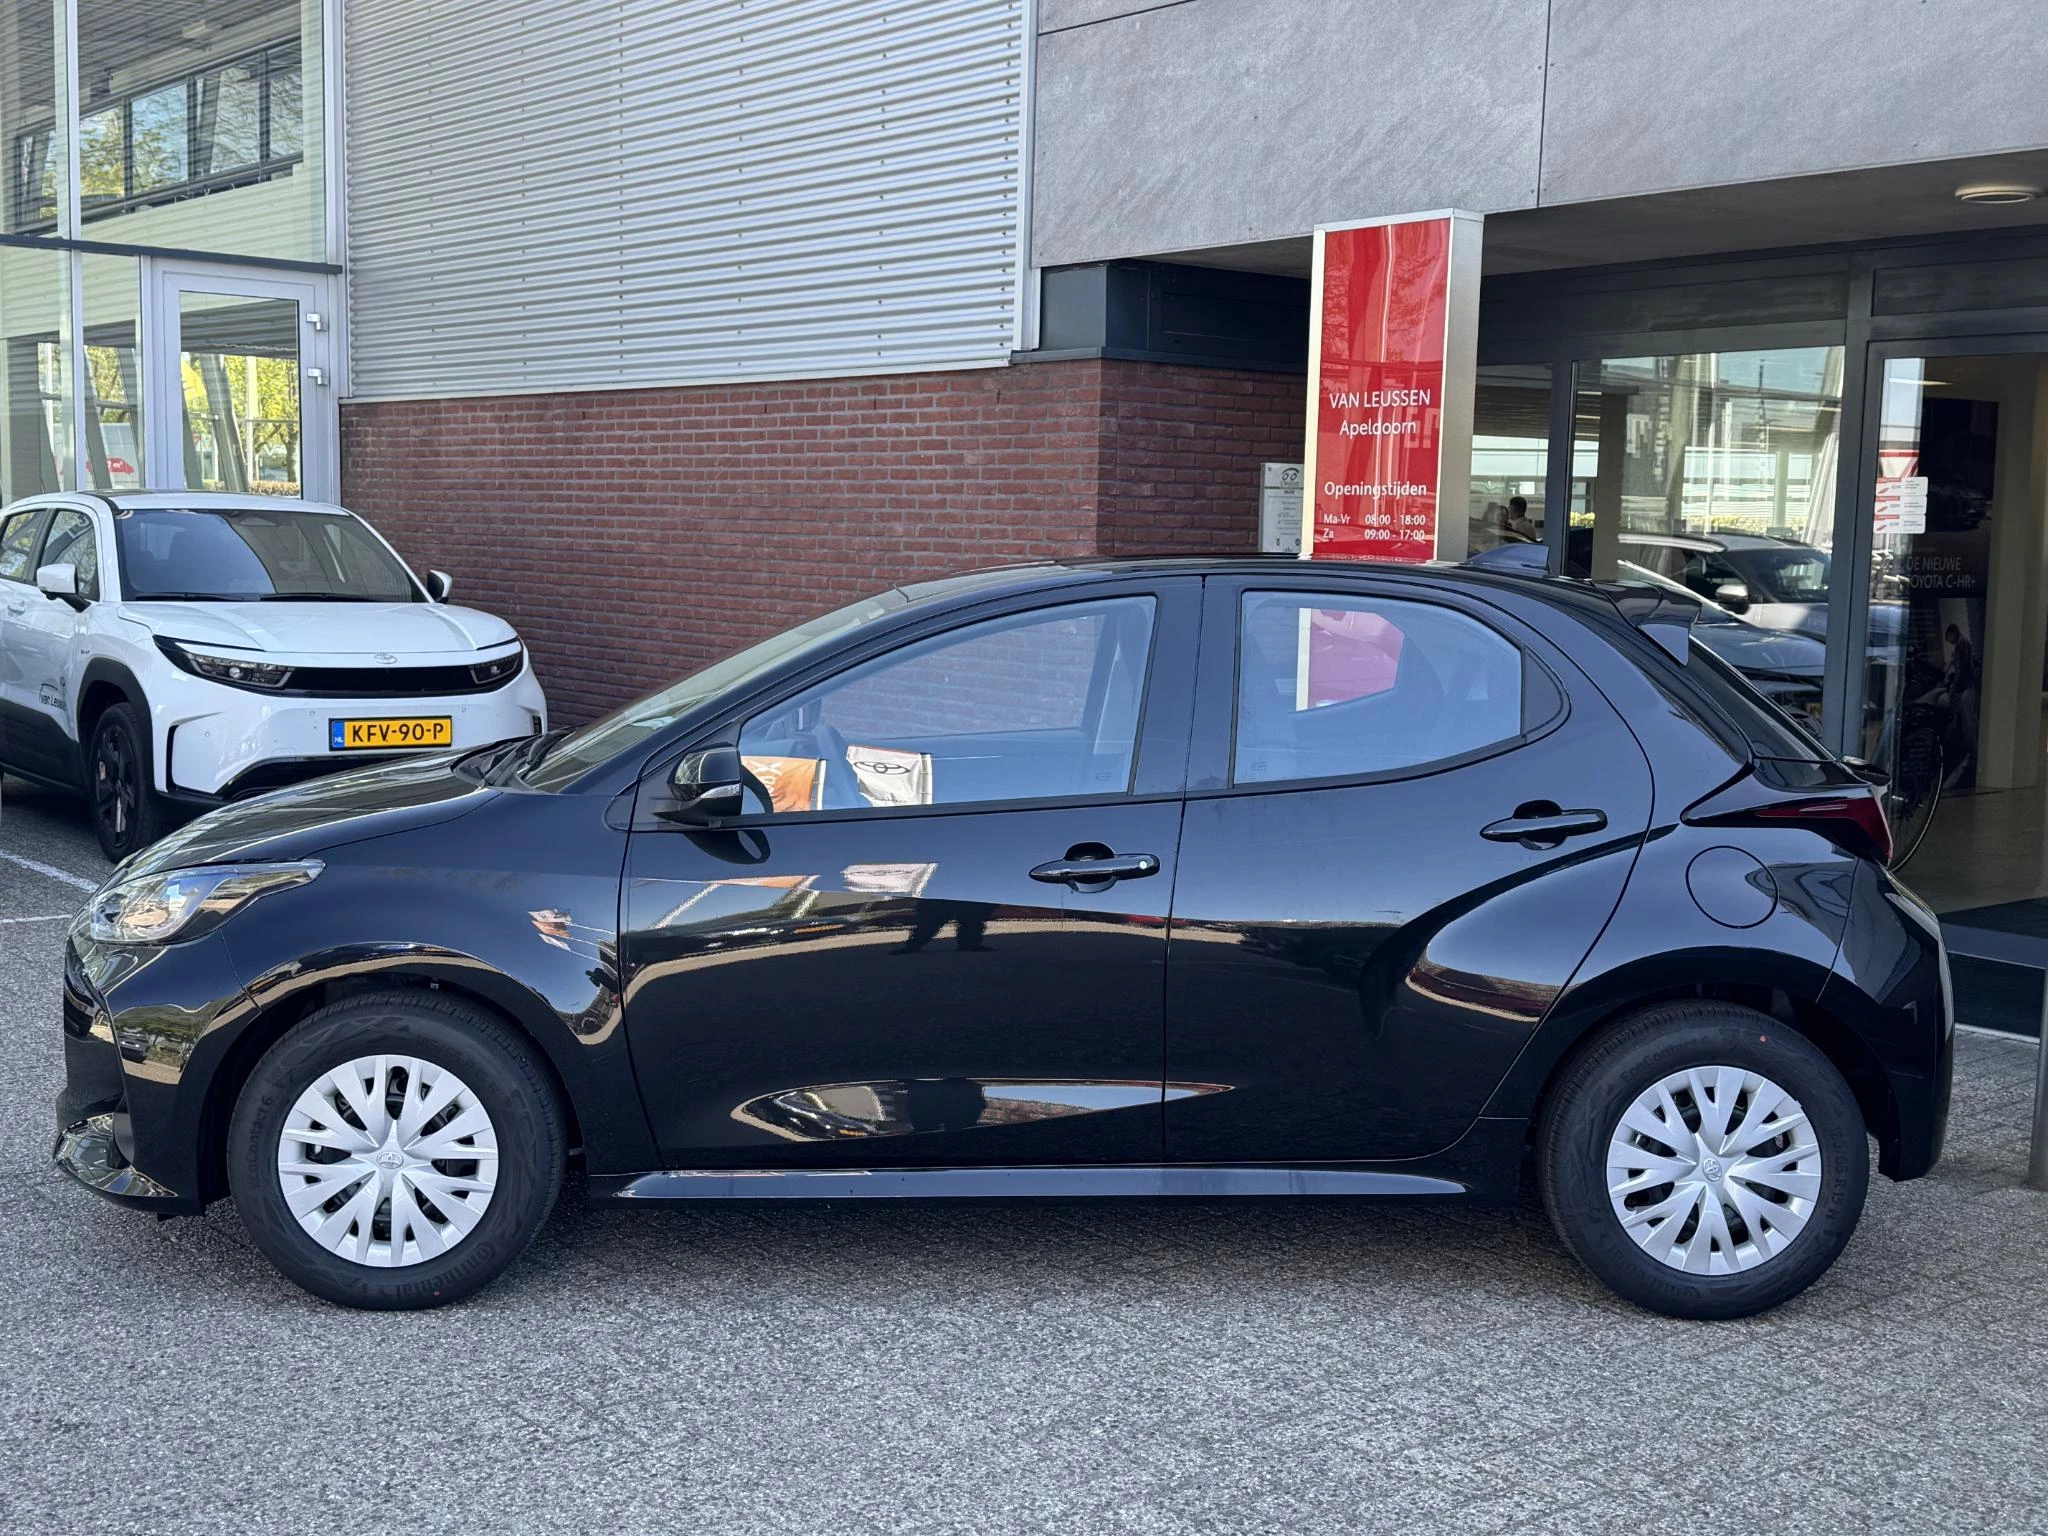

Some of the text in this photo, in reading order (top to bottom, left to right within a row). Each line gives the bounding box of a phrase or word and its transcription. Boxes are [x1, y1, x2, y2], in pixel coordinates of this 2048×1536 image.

[1330, 389, 1430, 408] VAN LEUSSEN
[1339, 419, 1416, 438] Apeldoorn
[1324, 481, 1427, 499] Openingstijden
[1323, 514, 1350, 525] Ma-Vr
[1365, 515, 1391, 525] 08:00
[1400, 515, 1426, 525] 18:00
[1323, 529, 1334, 539] Za
[1364, 530, 1390, 540] 09:00
[1399, 530, 1426, 540] 17:00
[1922, 558, 1961, 572] NIEUWE
[352, 723, 444, 743] KFV-90-P
